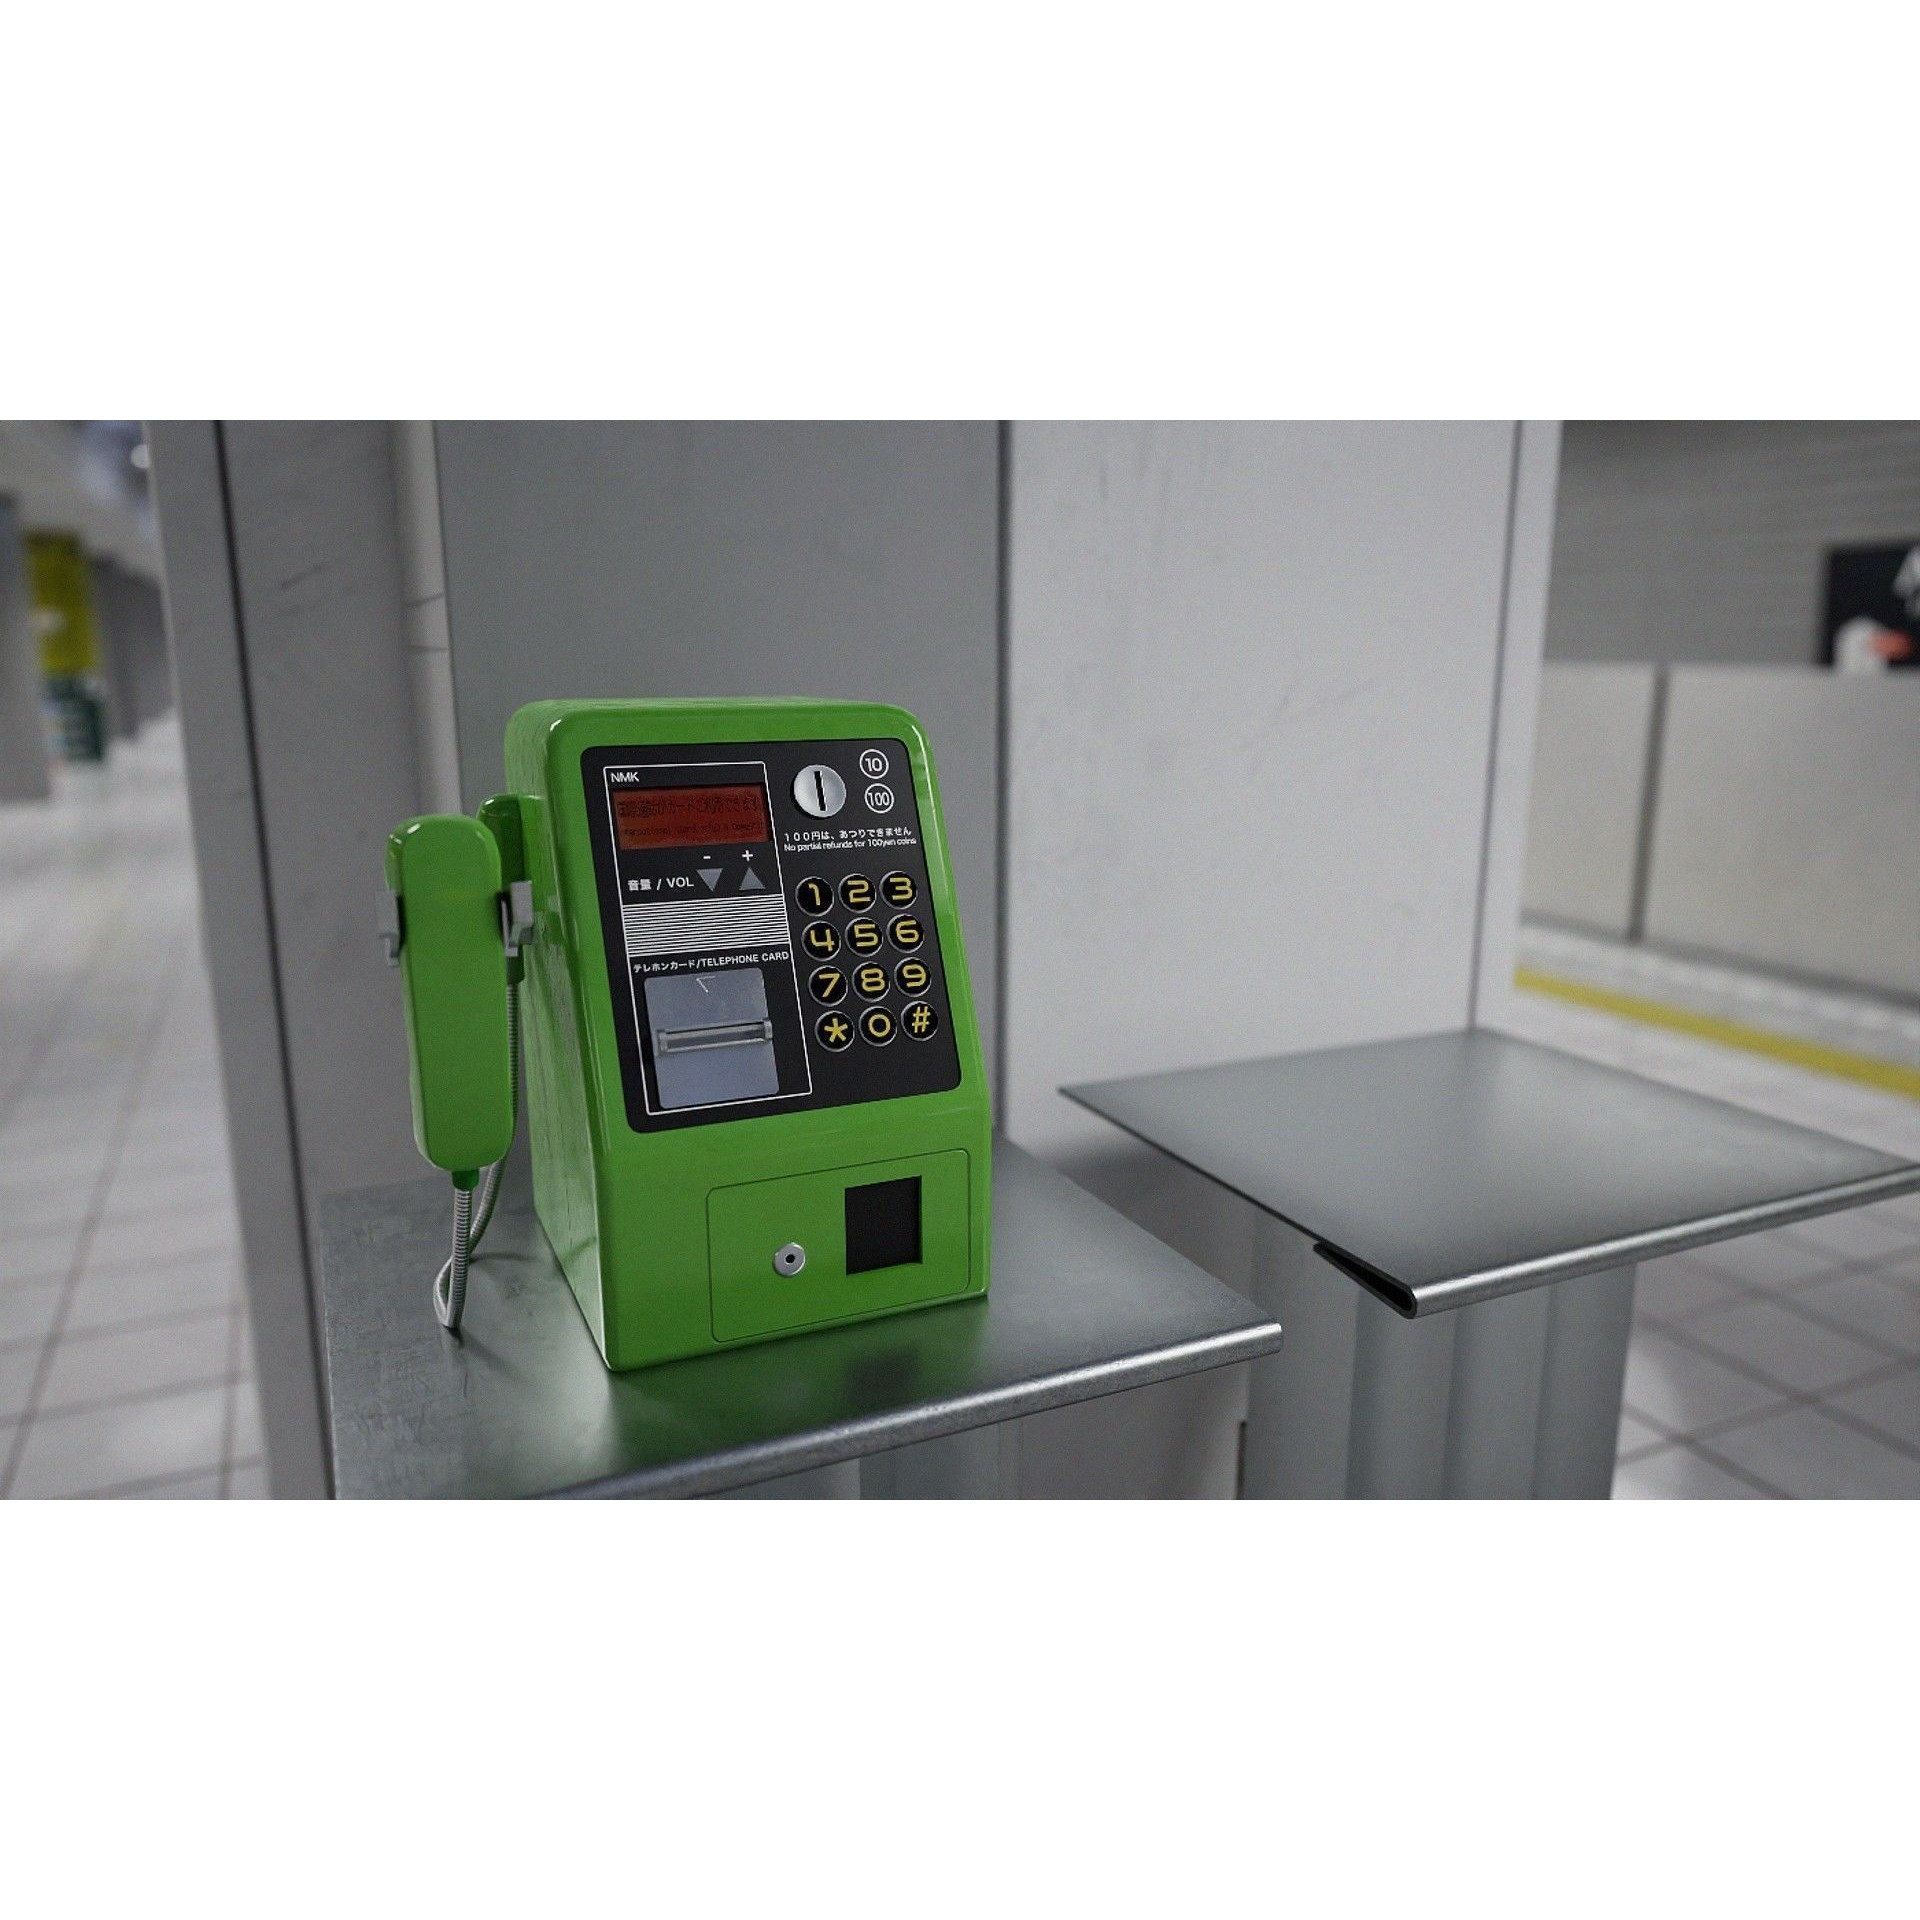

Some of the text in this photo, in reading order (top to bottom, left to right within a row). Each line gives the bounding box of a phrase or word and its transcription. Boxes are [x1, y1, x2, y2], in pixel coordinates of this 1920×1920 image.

[865, 757, 883, 772] 10
[610, 771, 640, 783] NMK
[868, 791, 890, 806] 100
[784, 836, 917, 852] No partial refunds for 100yen coins
[627, 878, 652, 891] 音量
[666, 876, 694, 888] VOL
[809, 884, 821, 905] 1
[848, 880, 870, 902] 2
[892, 878, 912, 900] 3
[811, 929, 834, 951] 4
[854, 924, 878, 947] 5
[896, 920, 919, 942] 6
[761, 951, 790, 961] CARD
[819, 973, 840, 997] 7
[861, 968, 885, 991] 8
[902, 963, 926, 987] 9
